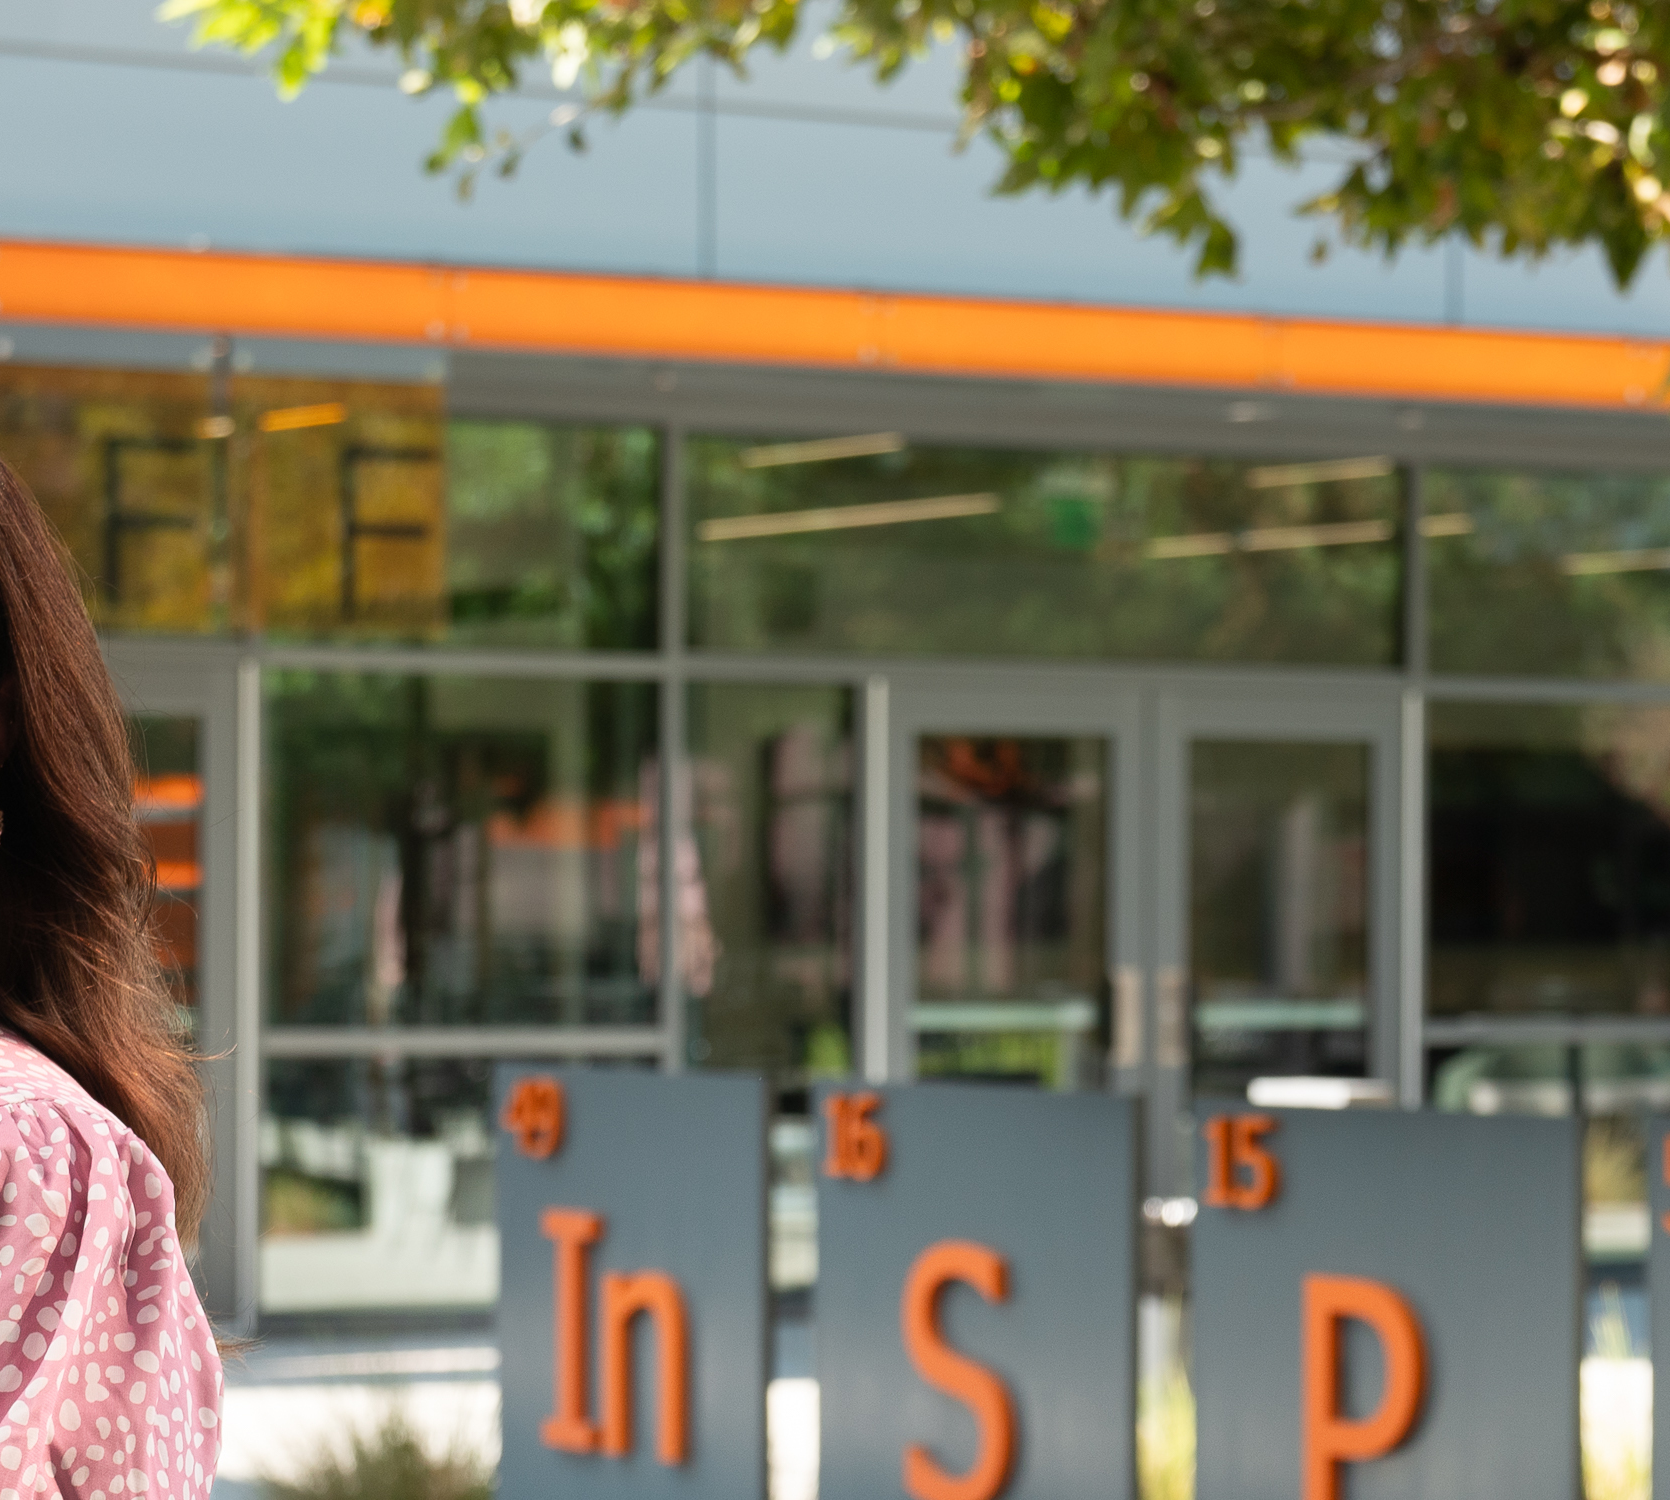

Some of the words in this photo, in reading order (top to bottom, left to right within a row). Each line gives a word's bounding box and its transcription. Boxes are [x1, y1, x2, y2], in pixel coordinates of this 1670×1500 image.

[505, 1077, 566, 1158] 49
[826, 1093, 889, 1180] 16
[1207, 1115, 1280, 1209] 15
[543, 1211, 691, 1465] In
